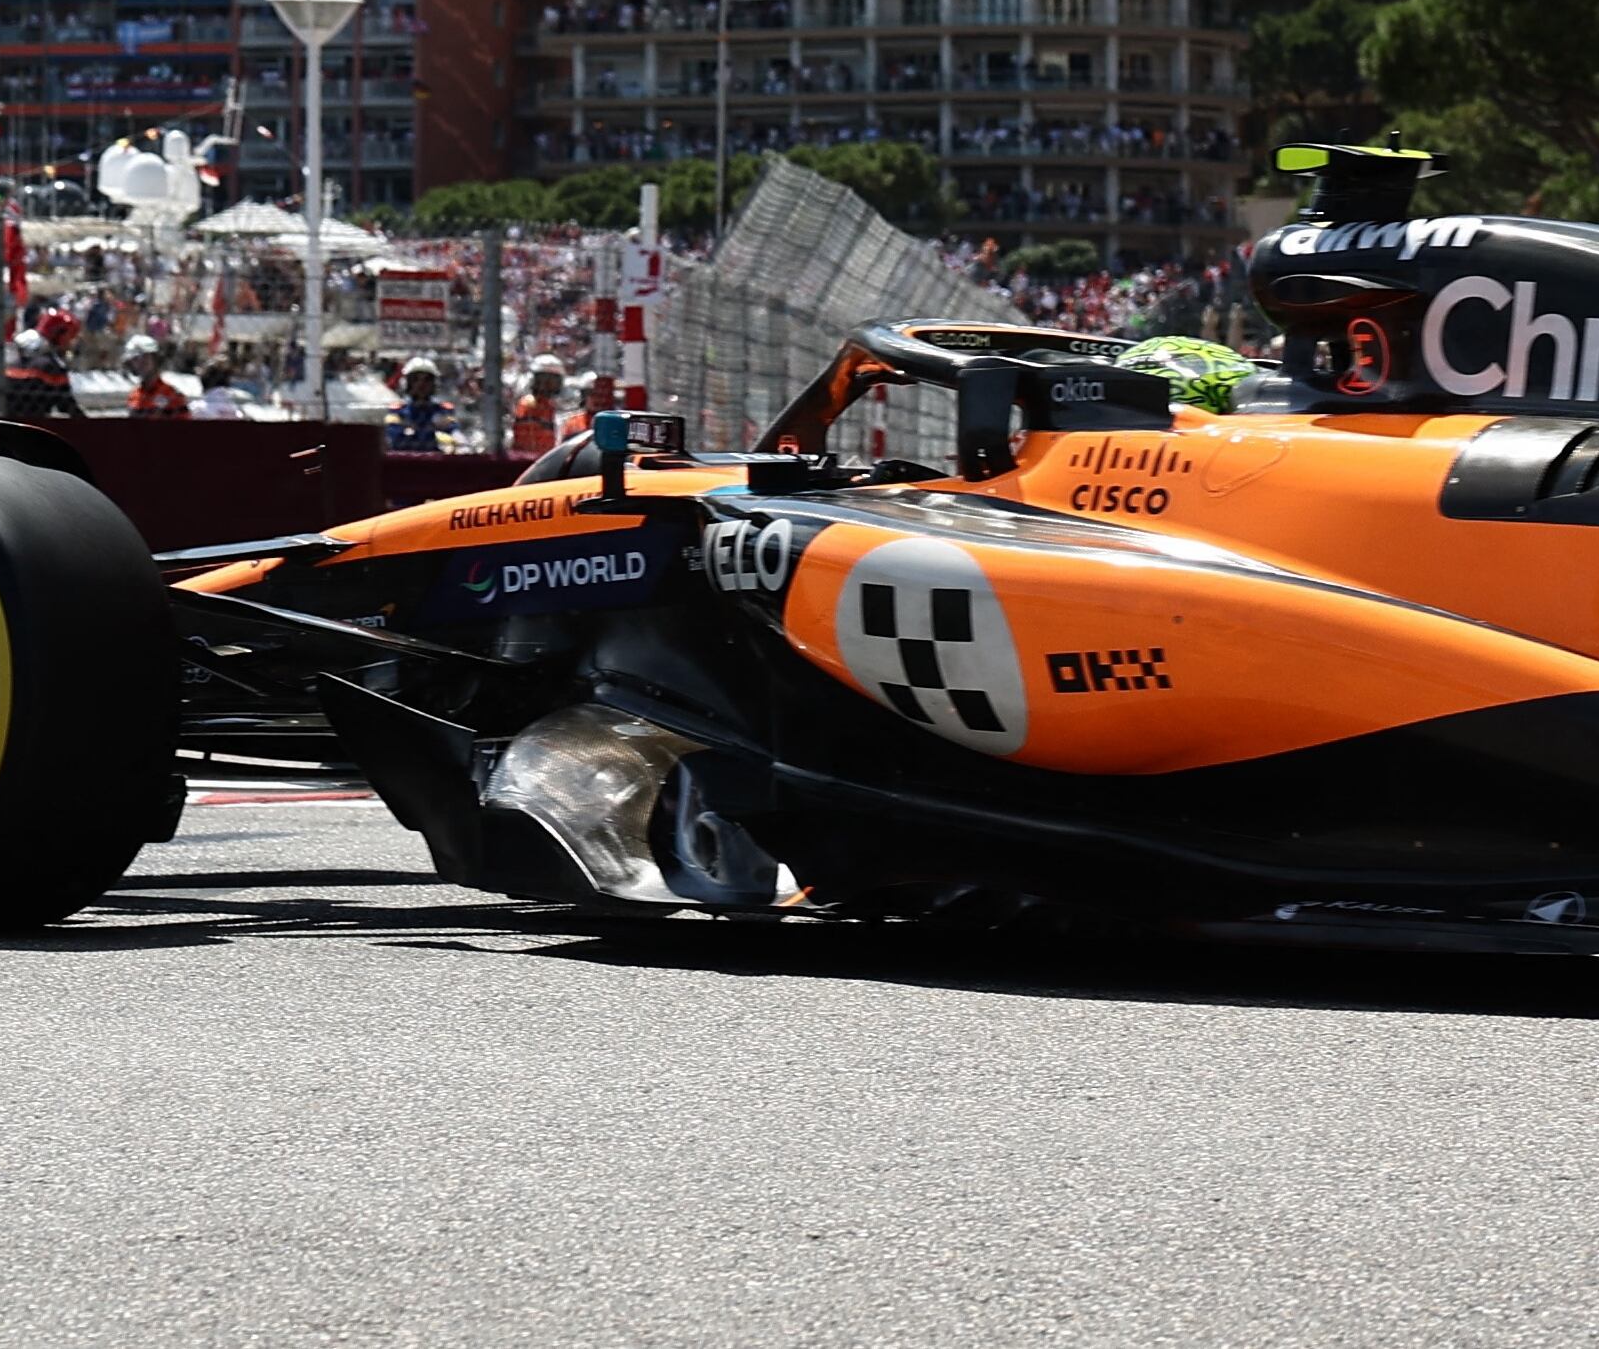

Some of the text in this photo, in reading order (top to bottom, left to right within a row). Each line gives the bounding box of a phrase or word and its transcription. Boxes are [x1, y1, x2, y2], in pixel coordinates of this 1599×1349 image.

[1069, 340, 1125, 356] CISCO
[1052, 376, 1106, 402] okta
[450, 497, 554, 531] RICHARD
[1071, 484, 1170, 515] CISCO
[503, 564, 542, 593] DP
[544, 551, 647, 588] WORLD
[1046, 647, 1173, 692] OKX
